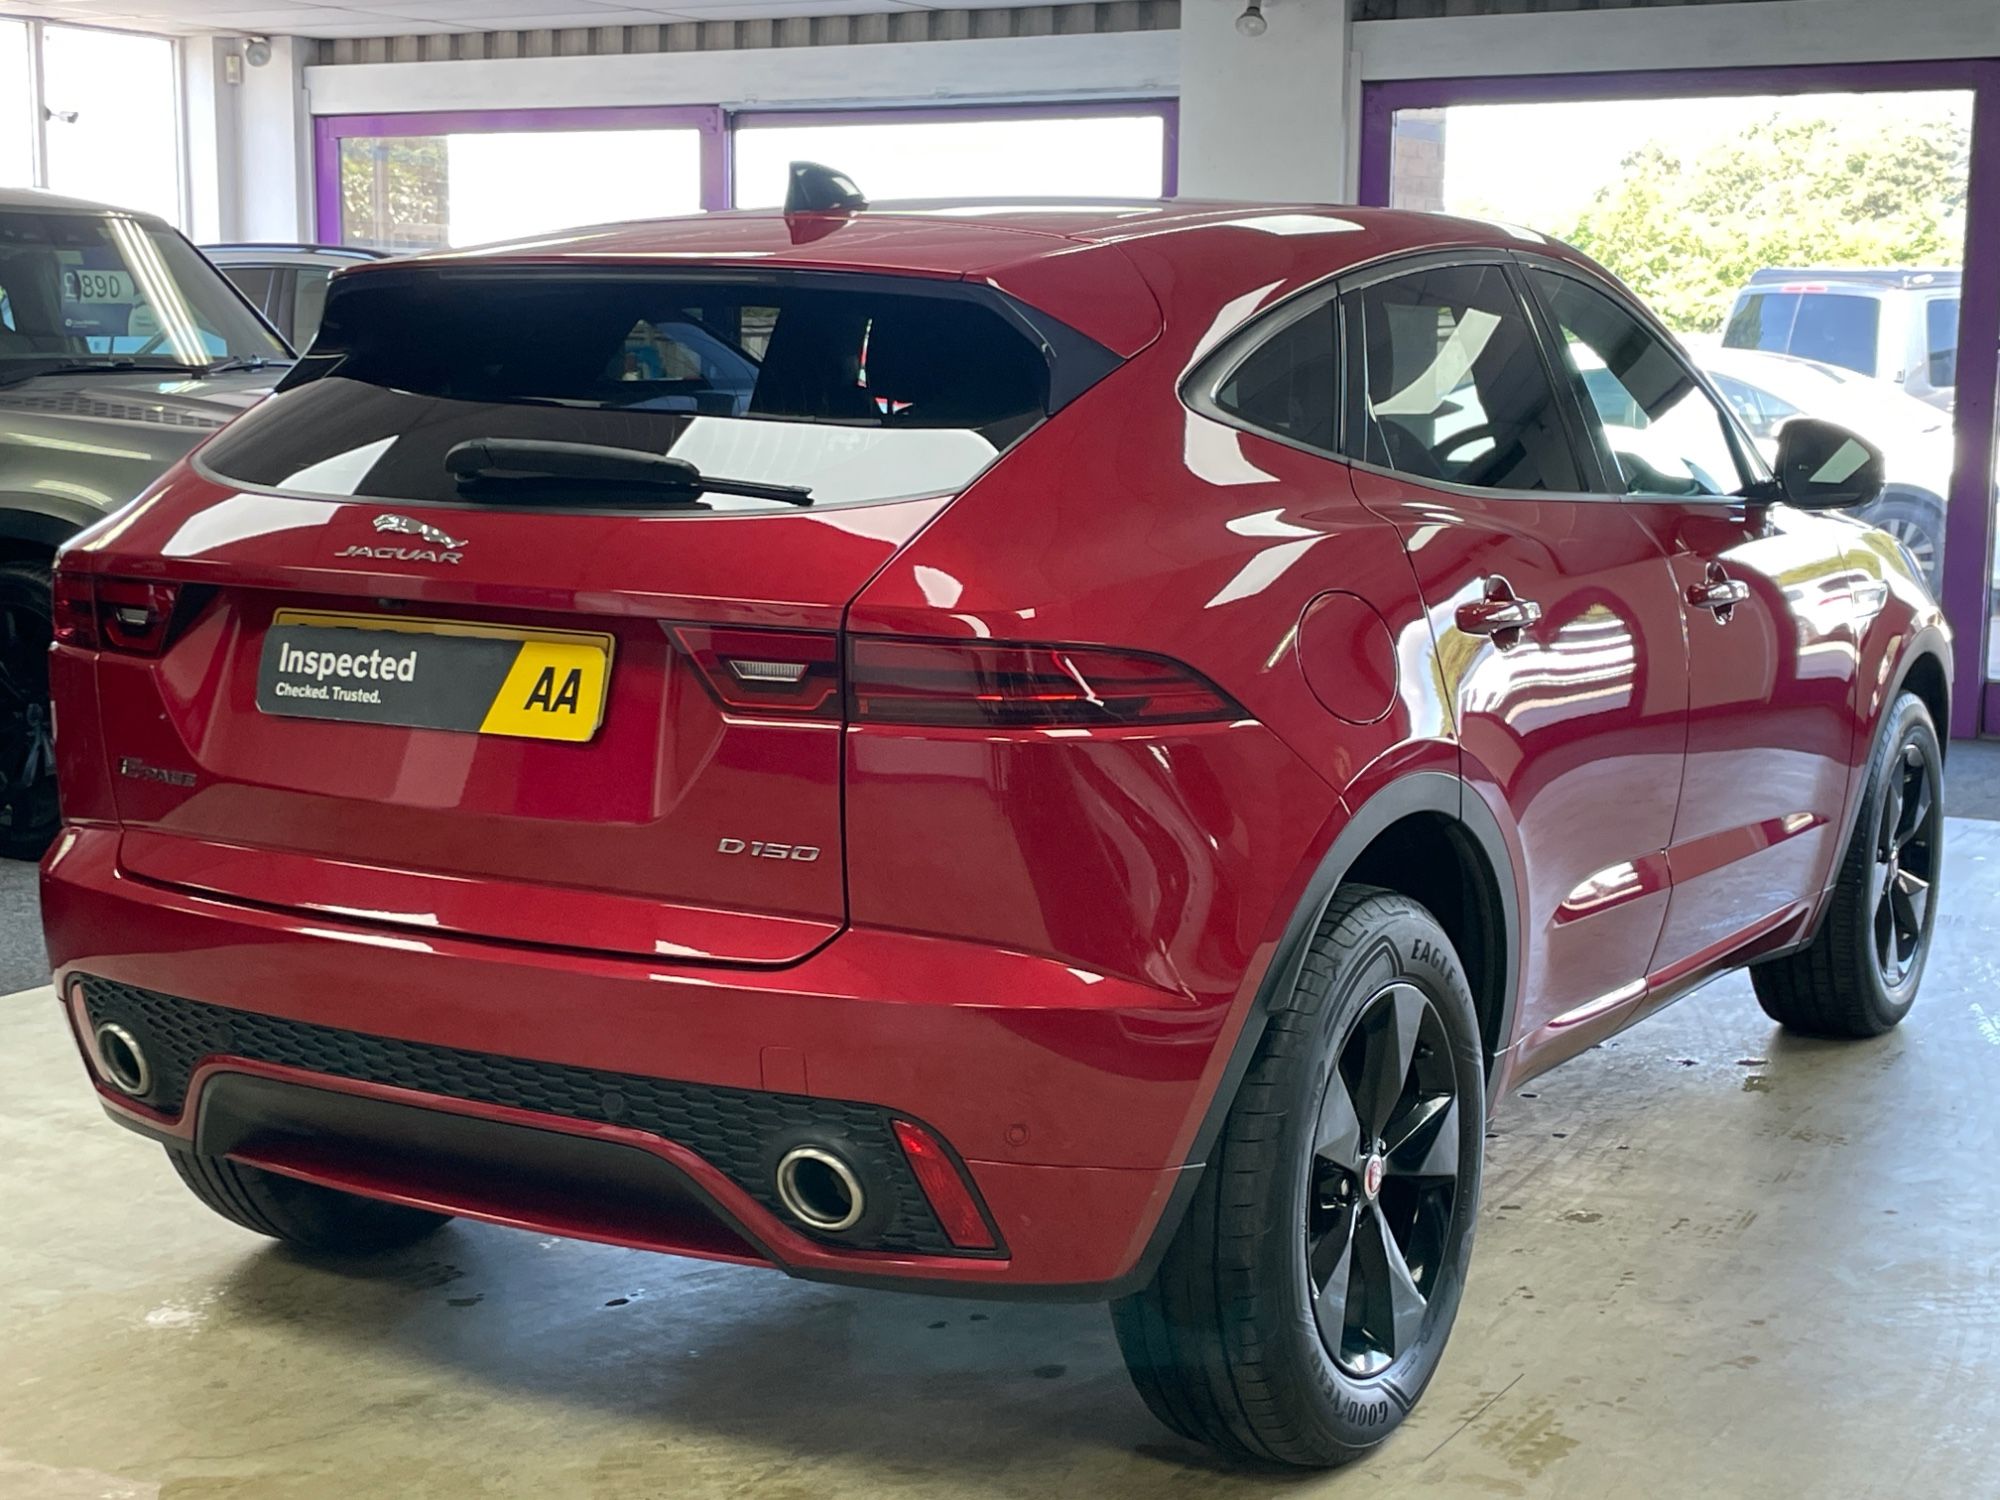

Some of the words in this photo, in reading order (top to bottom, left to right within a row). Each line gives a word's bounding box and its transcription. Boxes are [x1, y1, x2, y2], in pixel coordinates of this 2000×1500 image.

[334, 545, 464, 565] JAGUAR
[278, 642, 418, 682] Inspected
[275, 682, 330, 701] Checked.
[332, 685, 382, 705] Trusted.
[523, 665, 583, 714] AA
[1410, 938, 1457, 986] EAGLE
